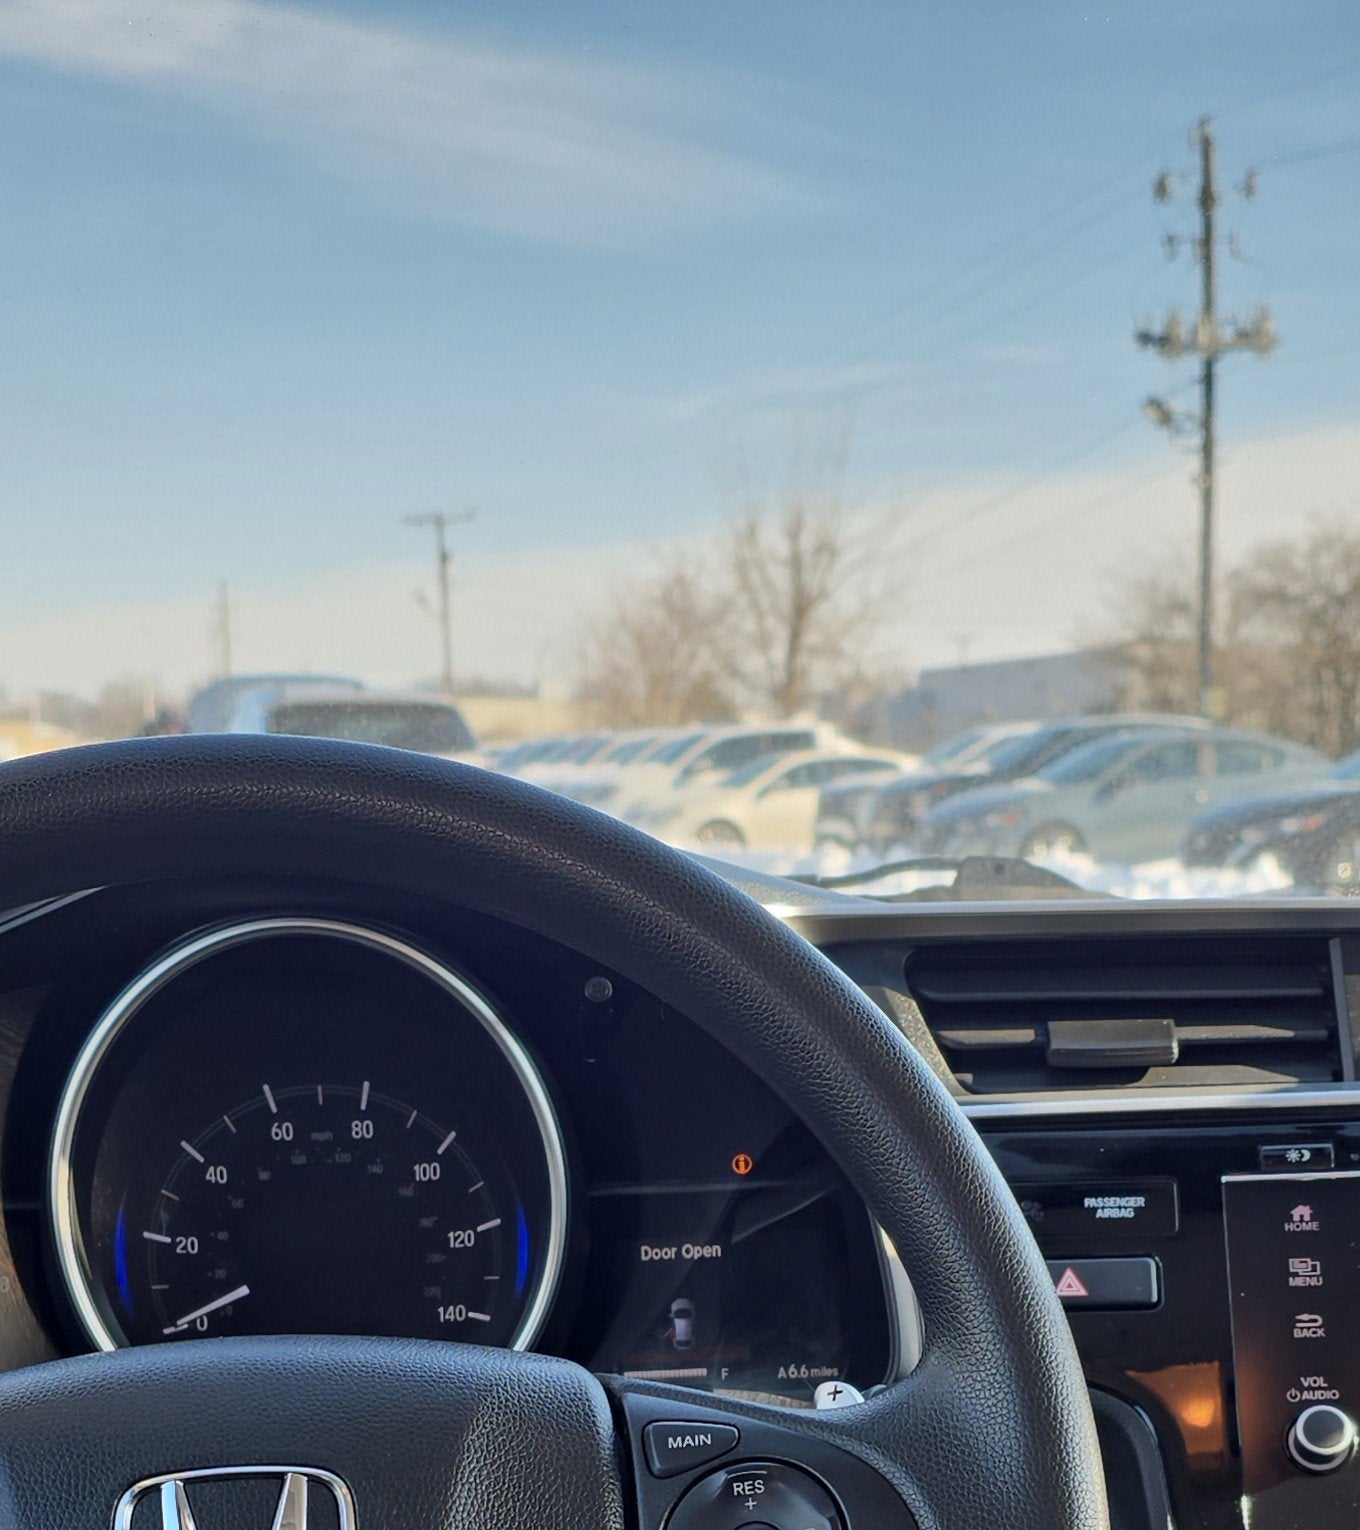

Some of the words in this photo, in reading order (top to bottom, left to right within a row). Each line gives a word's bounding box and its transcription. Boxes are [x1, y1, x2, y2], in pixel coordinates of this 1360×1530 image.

[271, 1122, 294, 1142] 60
[311, 1129, 334, 1143] mph
[351, 1120, 374, 1141] 80
[206, 1166, 227, 1185] 40
[413, 1162, 440, 1182] 100
[1084, 1196, 1145, 1208] PASSENGER
[1096, 1208, 1135, 1219] AIRBAG
[1285, 1221, 1319, 1232] HOME
[176, 1237, 198, 1255] 20
[448, 1230, 474, 1249] 120
[640, 1245, 677, 1261] Door
[682, 1243, 722, 1262] Open
[1289, 1276, 1323, 1287] MENU
[437, 1306, 467, 1323] 140
[196, 1315, 208, 1333] 0
[1294, 1326, 1325, 1338] BACK
[721, 1368, 729, 1380] F
[778, 1366, 787, 1379] A
[788, 1363, 809, 1379] 6.6
[810, 1365, 839, 1378] miles
[1300, 1376, 1328, 1388] VOL
[1302, 1389, 1339, 1401] AUDIO
[668, 1433, 712, 1449] MAIN
[733, 1480, 765, 1496] RES
